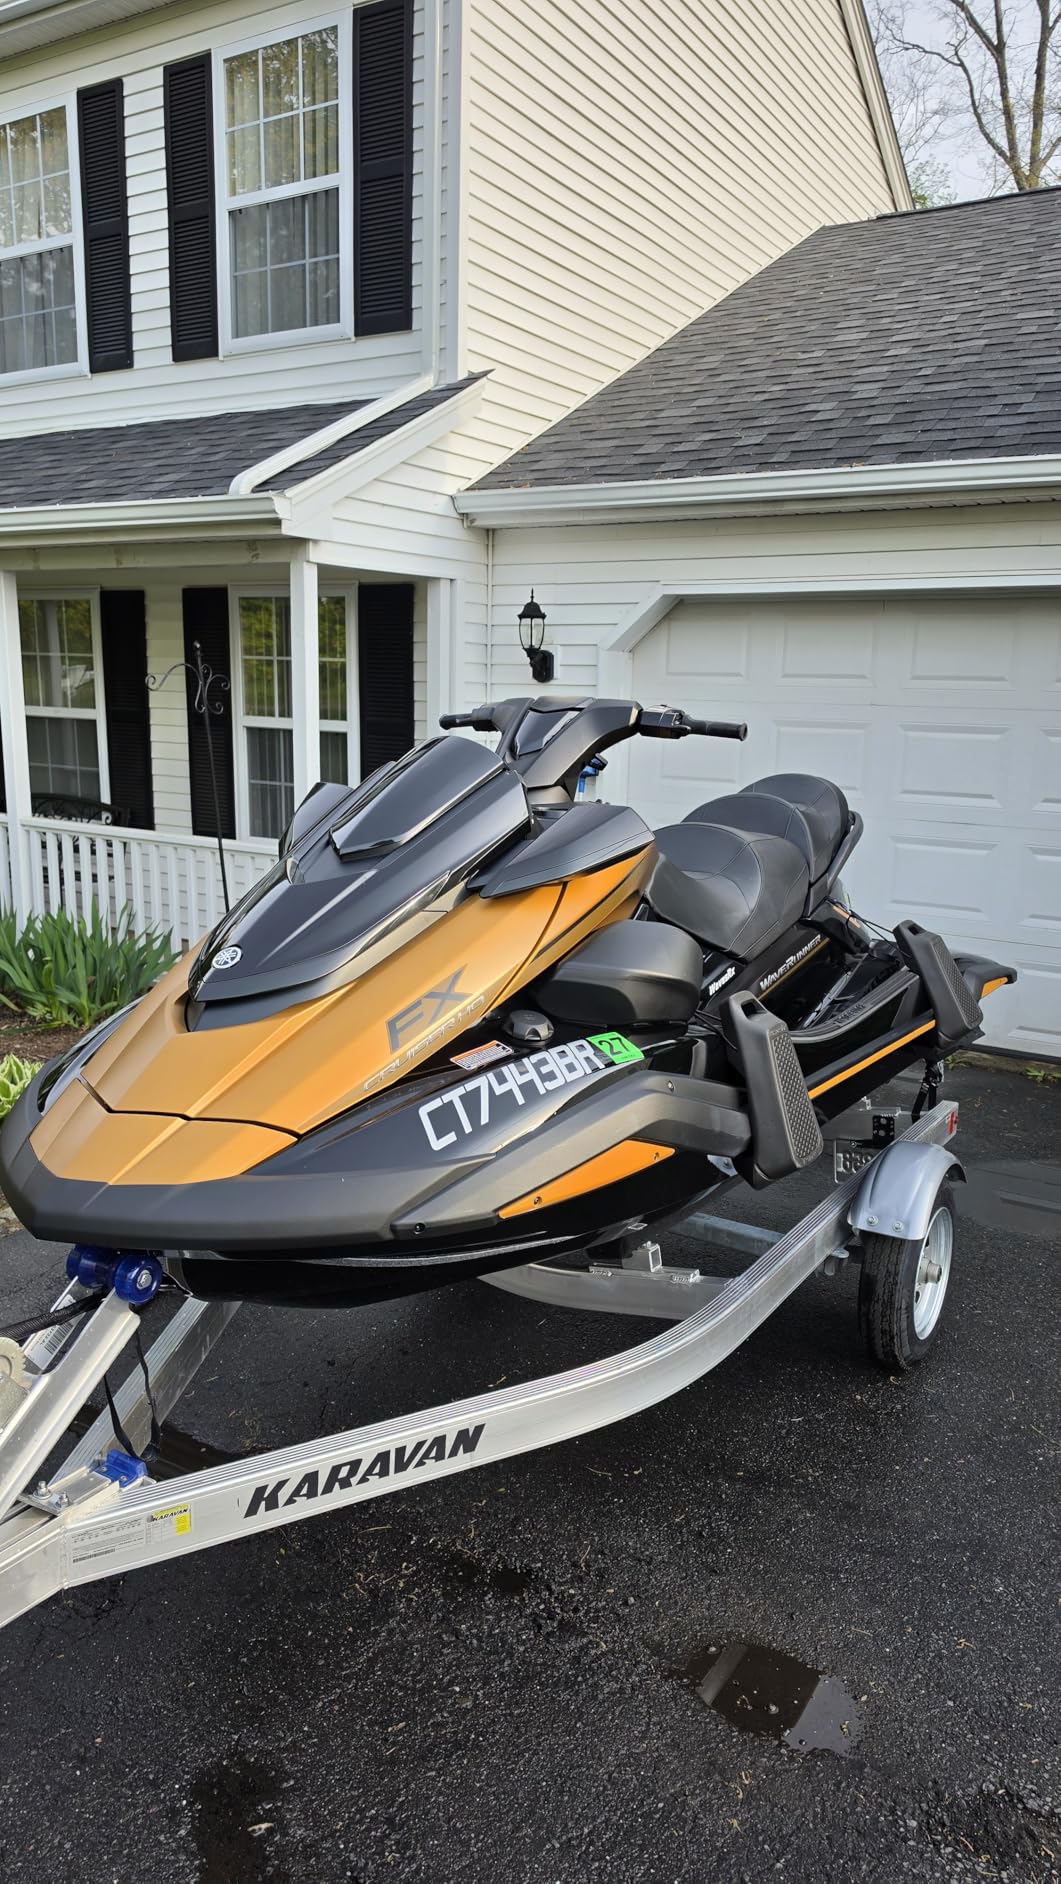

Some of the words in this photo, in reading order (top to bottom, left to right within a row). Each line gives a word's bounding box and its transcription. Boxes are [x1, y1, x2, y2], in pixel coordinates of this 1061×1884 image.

[363, 1018, 456, 1090] CRUISER
[385, 964, 476, 1055] FX
[598, 1036, 630, 1057] 27
[418, 1039, 606, 1151] CT7443BR
[243, 1423, 487, 1519] KARAVAN
